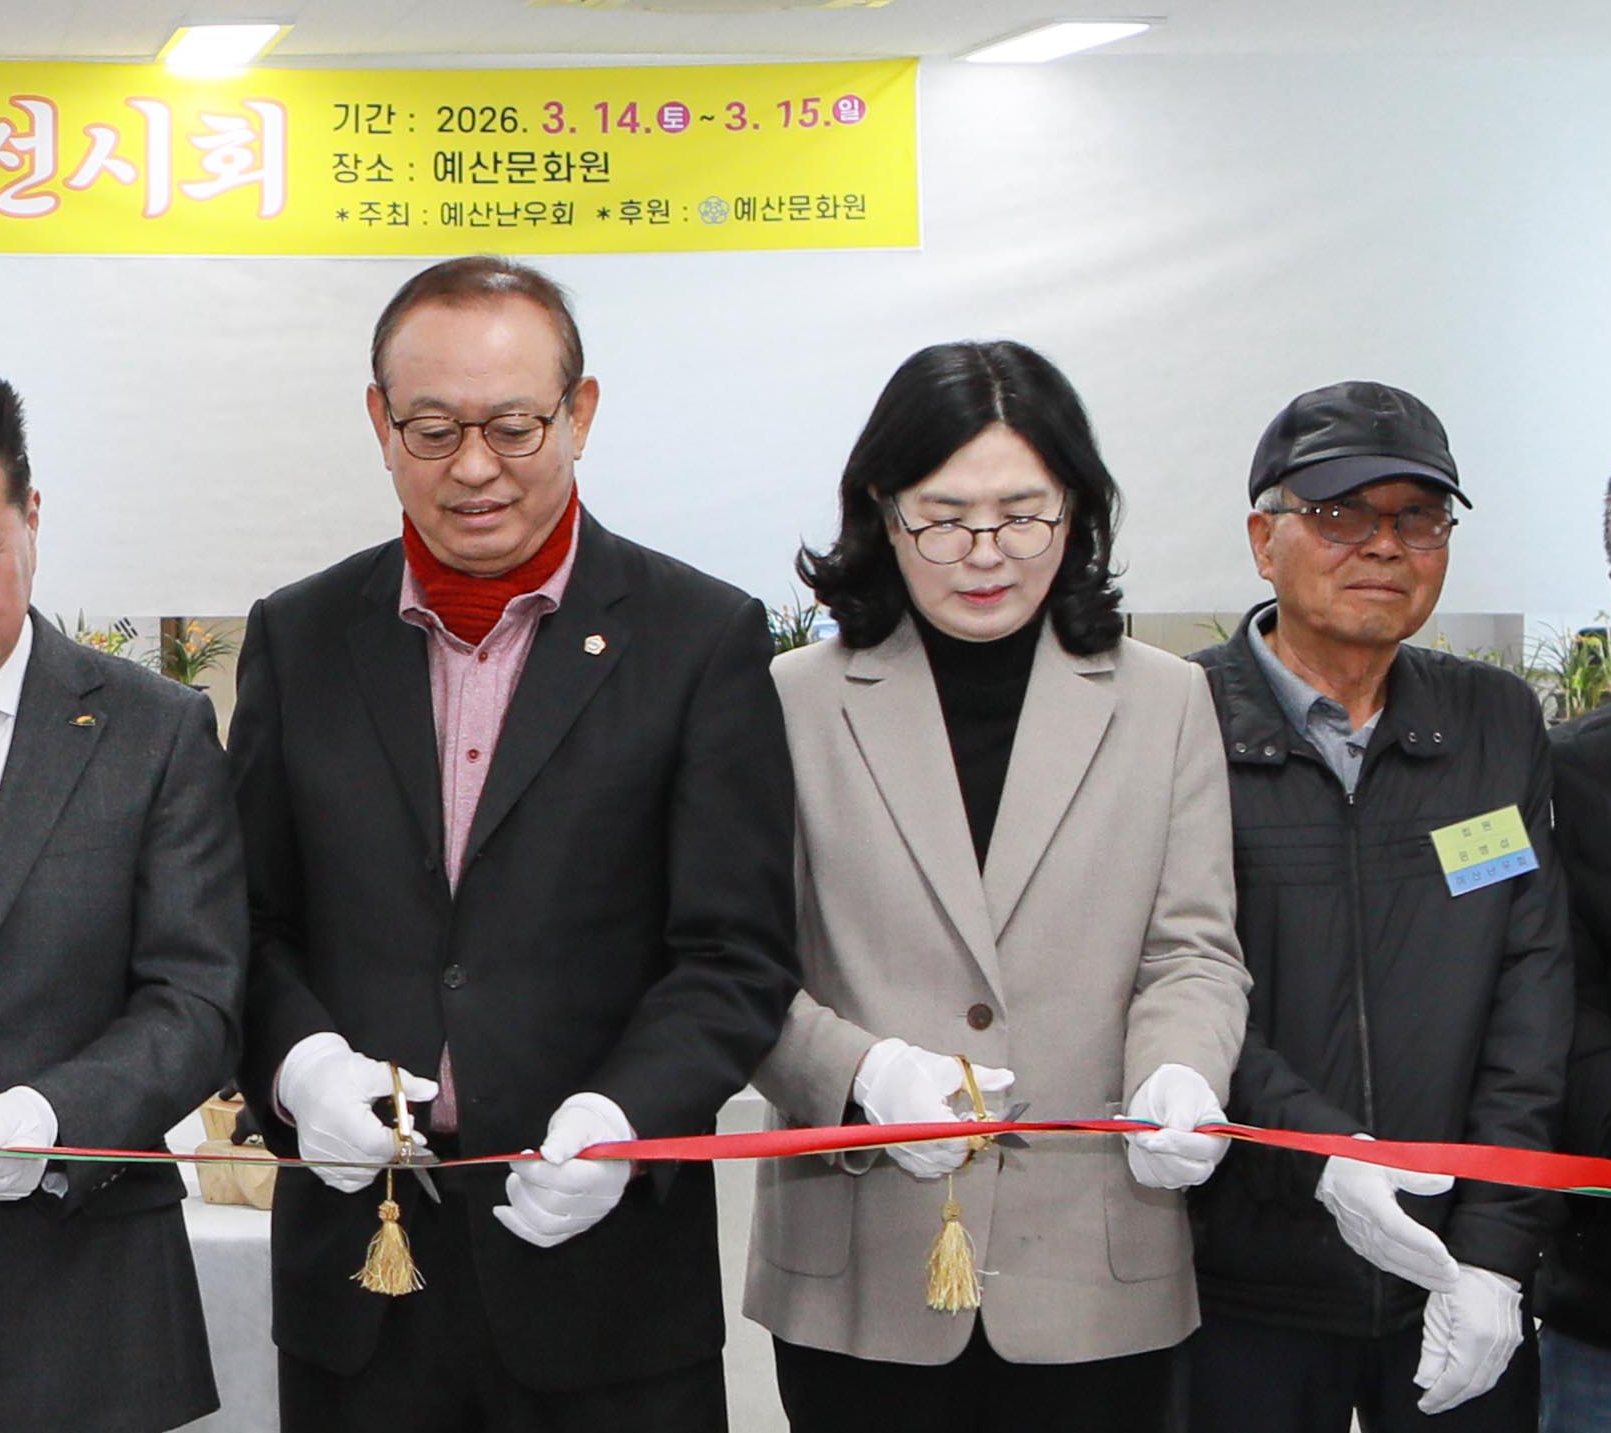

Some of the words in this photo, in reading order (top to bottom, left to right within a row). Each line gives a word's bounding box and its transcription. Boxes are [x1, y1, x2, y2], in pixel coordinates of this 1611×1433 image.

[333, 104, 396, 134] 기간
[437, 106, 528, 133] 2026.
[541, 100, 577, 134] 3.
[724, 101, 760, 131] 3.
[333, 152, 394, 183] 장소
[433, 151, 610, 184] 예산문화원
[359, 201, 410, 226] 주최
[440, 201, 574, 227] 예산난우회
[619, 198, 670, 225] 후원
[734, 193, 867, 223] 예산문화원
